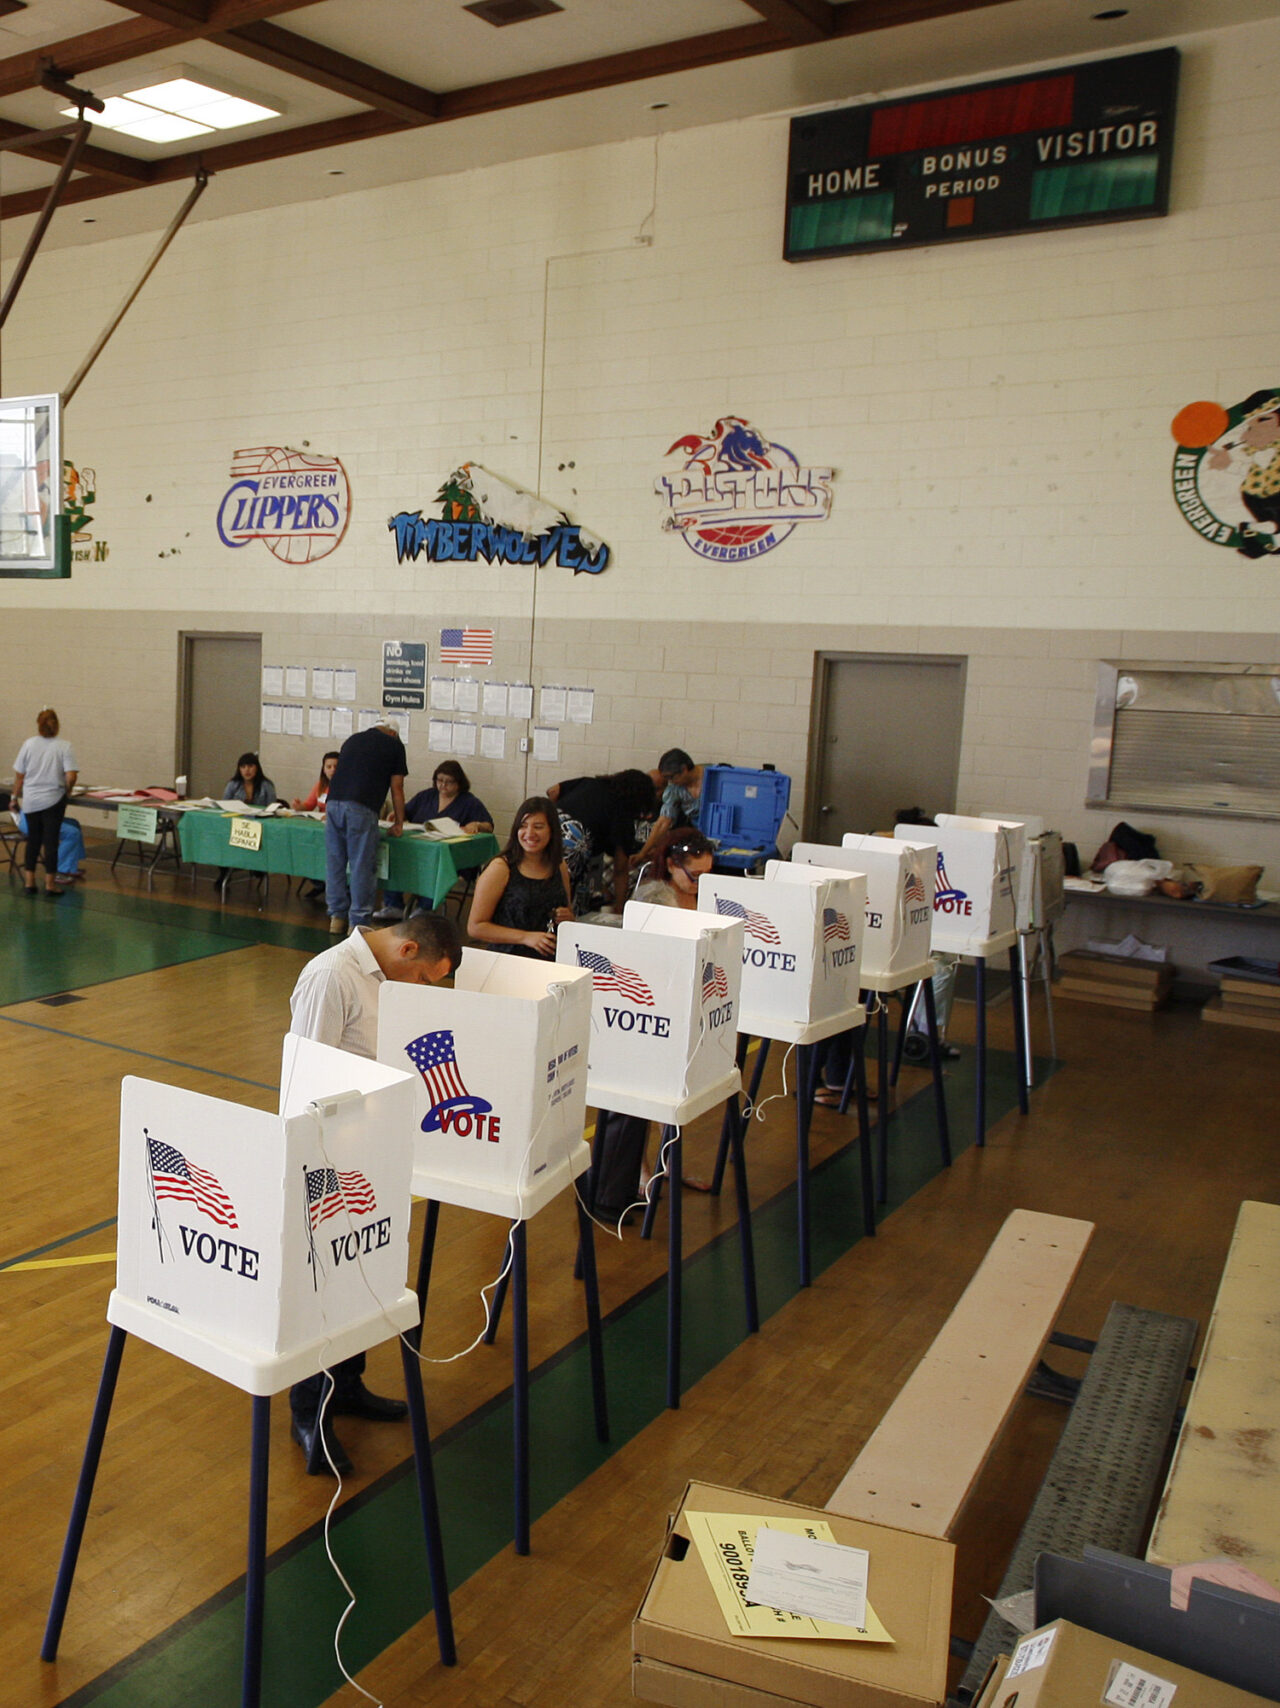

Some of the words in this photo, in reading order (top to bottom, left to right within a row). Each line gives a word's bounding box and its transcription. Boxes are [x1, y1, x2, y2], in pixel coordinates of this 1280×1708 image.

[1037, 120, 1158, 162] VISITOR
[922, 145, 1008, 175] BONUS
[808, 164, 881, 197] HOME
[925, 175, 1001, 198] PERIOD
[262, 474, 337, 489] EVERGREEN
[1174, 453, 1233, 544] EVERGREEN
[217, 480, 339, 548] CLIPPERS
[694, 532, 777, 559] EVERGREEN
[386, 646, 402, 657] NO
[385, 694, 401, 704] Gym
[910, 906, 929, 925] VOTE
[933, 898, 973, 916] VOTE
[742, 948, 796, 972] VOTE
[831, 945, 856, 968] VOTE
[603, 1007, 671, 1038] VOTE
[709, 1001, 733, 1030] VOTE
[438, 1108, 501, 1143] VOTE
[179, 1225, 260, 1281] VOTE
[331, 1217, 391, 1267] VOTE
